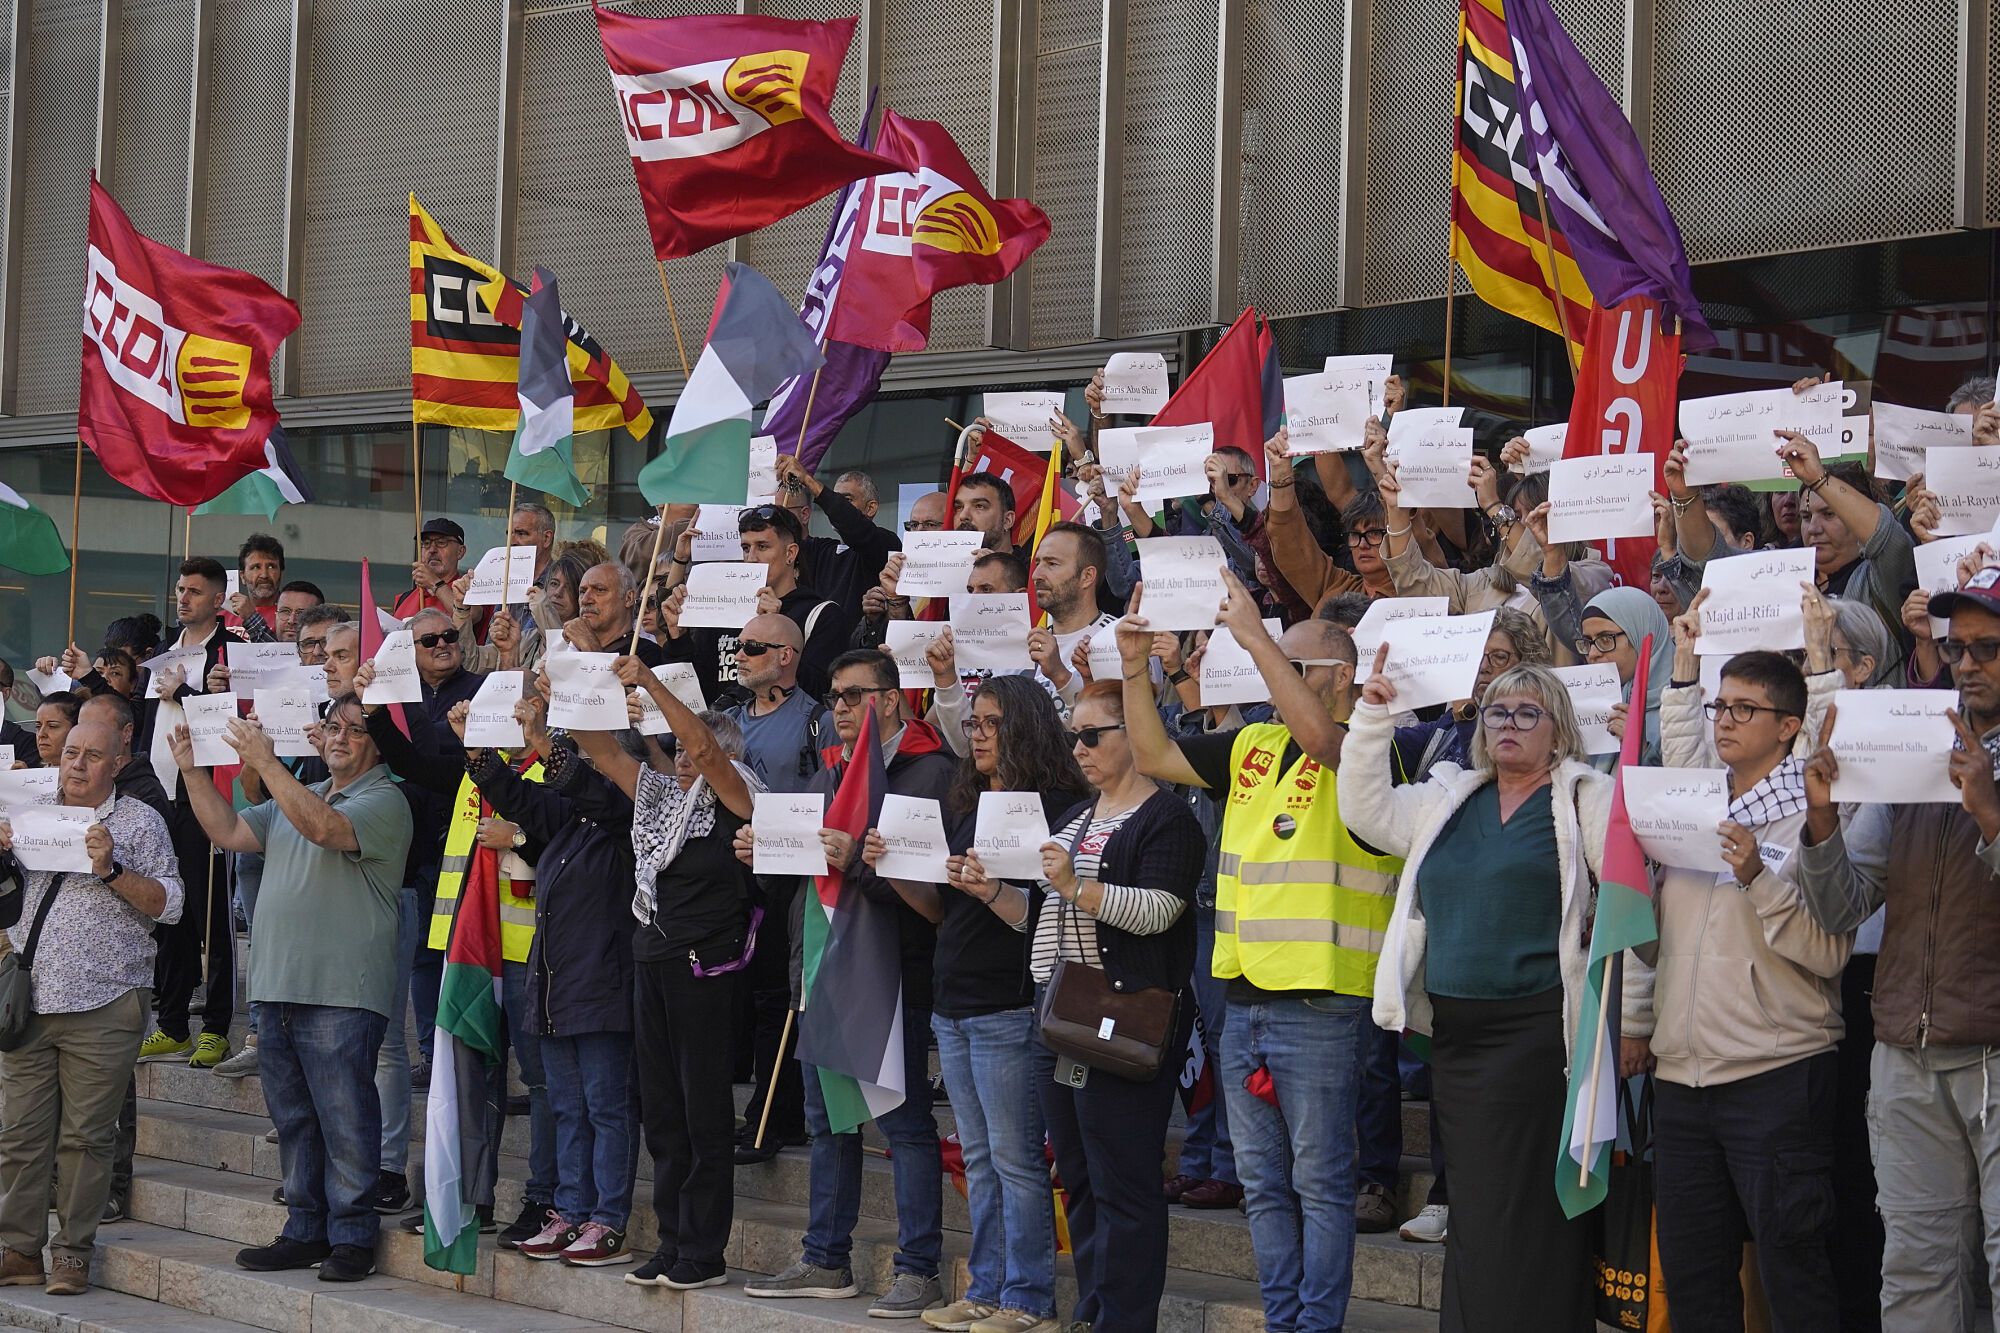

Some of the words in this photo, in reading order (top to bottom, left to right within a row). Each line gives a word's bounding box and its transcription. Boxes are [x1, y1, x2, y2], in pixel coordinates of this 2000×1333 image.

[1105, 386, 1124, 394] Faris
[1126, 385, 1141, 394] Abu
[1308, 413, 1340, 427] Sharaf
[992, 424, 1009, 433] Hala
[1011, 424, 1026, 432] Abu
[1028, 423, 1052, 432] Saada
[1715, 434, 1735, 443] Khalil
[1736, 432, 1757, 441] Imran
[1880, 440, 1895, 451] Julia
[1105, 465, 1124, 477] Tala
[1163, 464, 1187, 476] Obeid
[1423, 466, 1434, 474] Abu
[1583, 464, 1623, 480] الشعراوي
[1626, 465, 1647, 477] مريم
[1553, 498, 1584, 509] Mariam
[1585, 494, 1630, 505] al-Sharawi
[1934, 495, 1946, 507] Ali
[697, 530, 724, 541] Ikhlas
[906, 561, 938, 569] Mohammed
[1750, 561, 1786, 579] الرفاعي
[471, 579, 494, 588] Suhaib
[1143, 578, 1165, 590] Walid
[1167, 578, 1183, 590] Abu
[1184, 577, 1217, 591] Thuraya
[688, 595, 716, 603] Ibrahim
[718, 595, 737, 605] Ishaq
[738, 595, 757, 604] Abed
[1706, 608, 1734, 624] Majd
[1737, 604, 1780, 620] al-Rifai
[955, 628, 976, 637] Ahmed
[1386, 657, 1409, 672] Ahmed
[1409, 651, 1439, 667] Sheikh
[1440, 652, 1469, 664] al-Eid
[387, 666, 413, 676] Shaheen
[1206, 667, 1232, 679] Rimas
[553, 691, 572, 702] Fidaa
[572, 692, 605, 706] Ghareeb
[640, 703, 661, 714] Mala
[277, 726, 301, 735] al-Attar
[1834, 741, 1854, 751] Saba
[1855, 741, 1904, 752] Mohammed
[1905, 741, 1928, 753] Salha
[1631, 818, 1653, 832] Qatar
[1654, 817, 1671, 831] Abu
[13, 835, 49, 847] al-Baraa
[51, 837, 73, 849] Aqel
[756, 837, 784, 849] Sujoud
[784, 837, 804, 848] Taha
[900, 837, 933, 850] Tamraz
[975, 836, 991, 848] Sara
[992, 835, 1020, 849] Qandil
